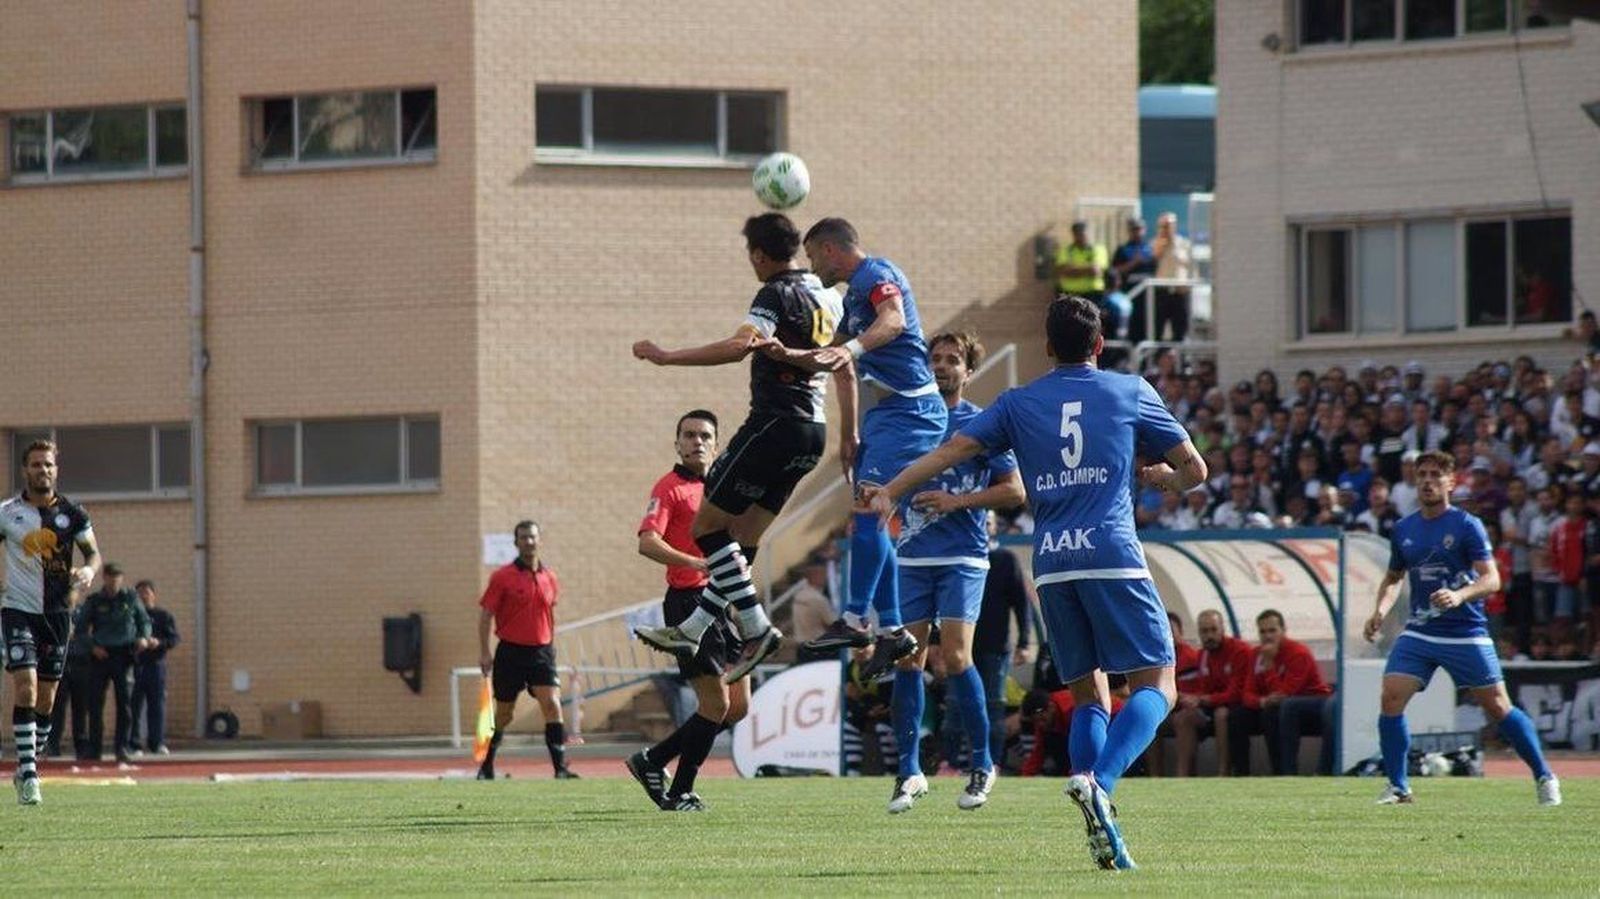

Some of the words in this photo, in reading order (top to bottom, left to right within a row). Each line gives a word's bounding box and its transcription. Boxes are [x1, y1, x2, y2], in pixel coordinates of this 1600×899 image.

[1060, 401, 1084, 470] 5
[1036, 473, 1057, 492] C.D.
[1039, 527, 1096, 556] AAK
